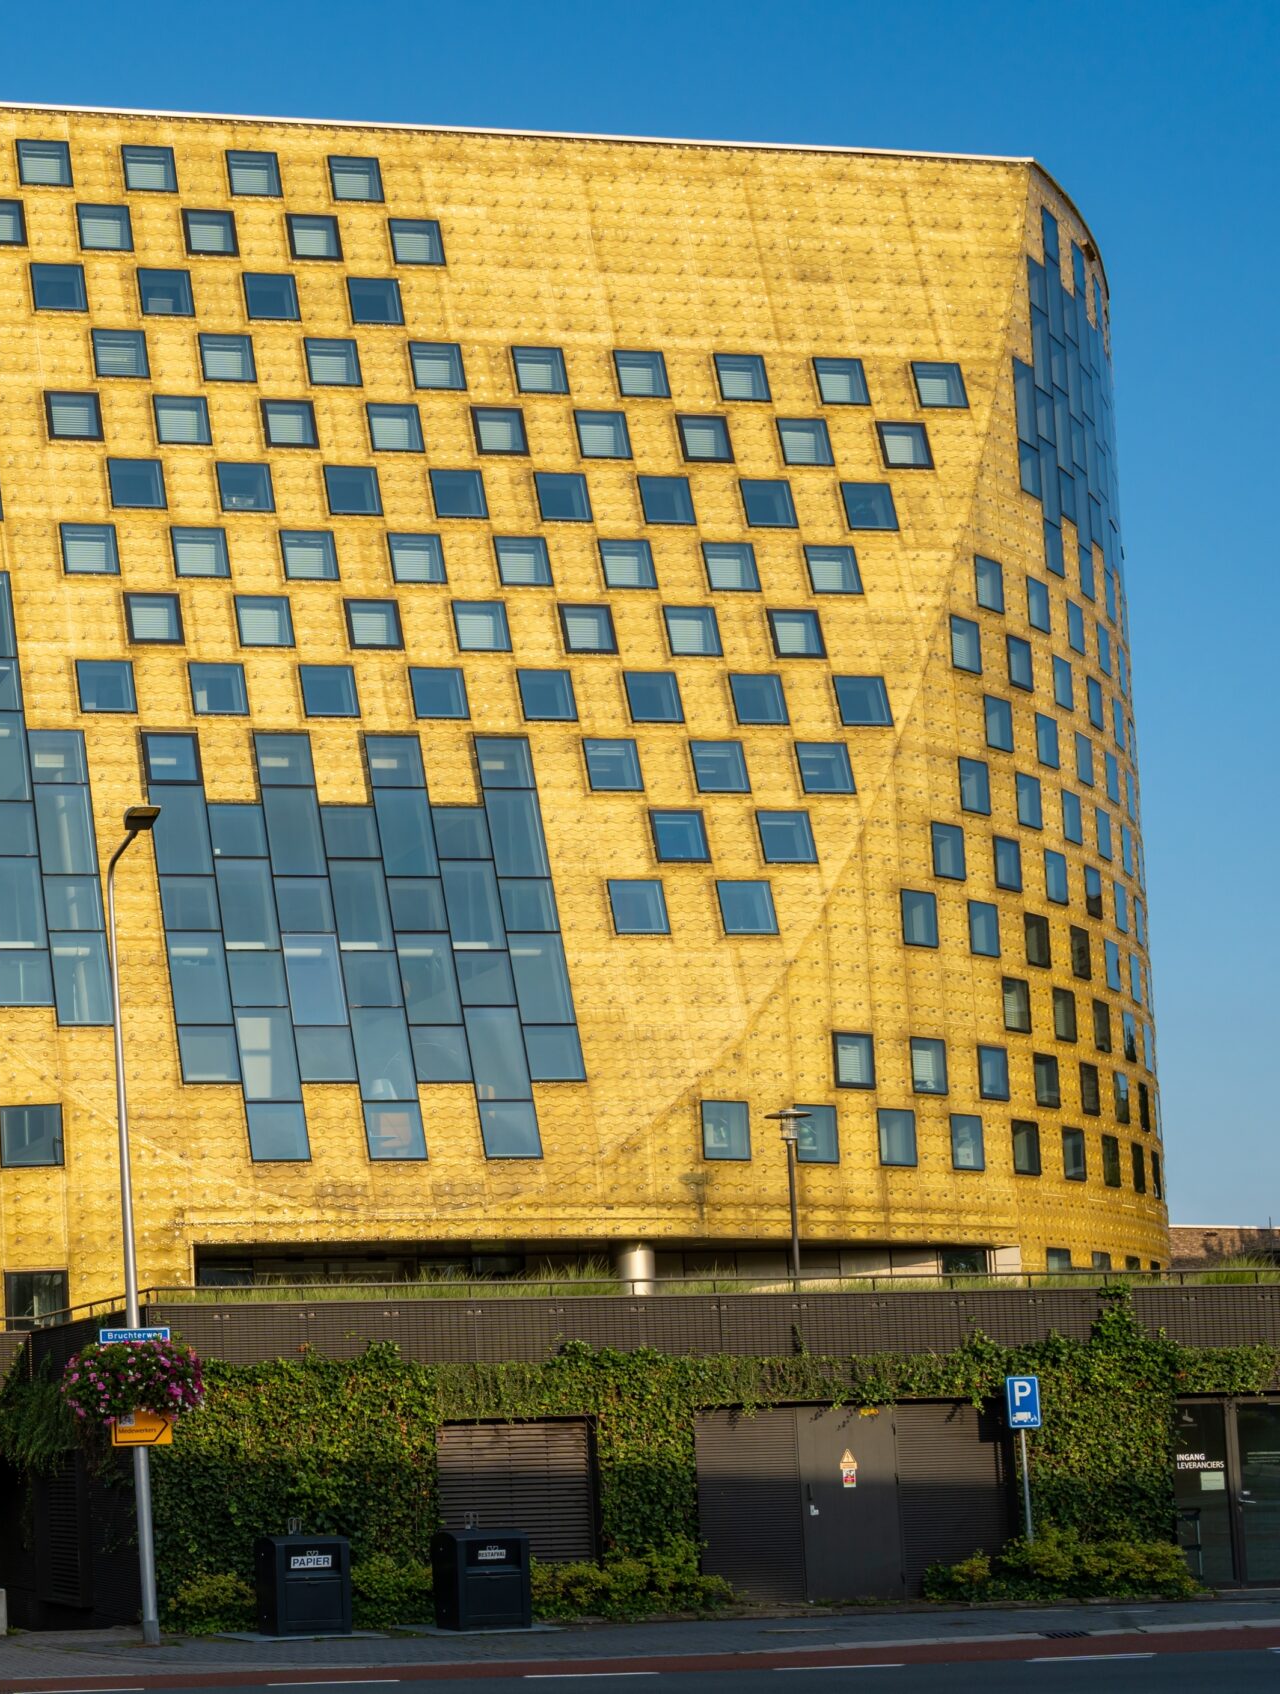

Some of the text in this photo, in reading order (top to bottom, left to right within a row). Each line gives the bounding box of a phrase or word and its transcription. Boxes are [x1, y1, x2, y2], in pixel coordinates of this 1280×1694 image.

[107, 1332, 163, 1340] Bruchterweg
[1013, 1381, 1031, 1407] P
[1176, 1453, 1206, 1461] INGANG
[1176, 1461, 1225, 1470] LEVERANCIERS
[292, 1556, 331, 1567] PAPIER
